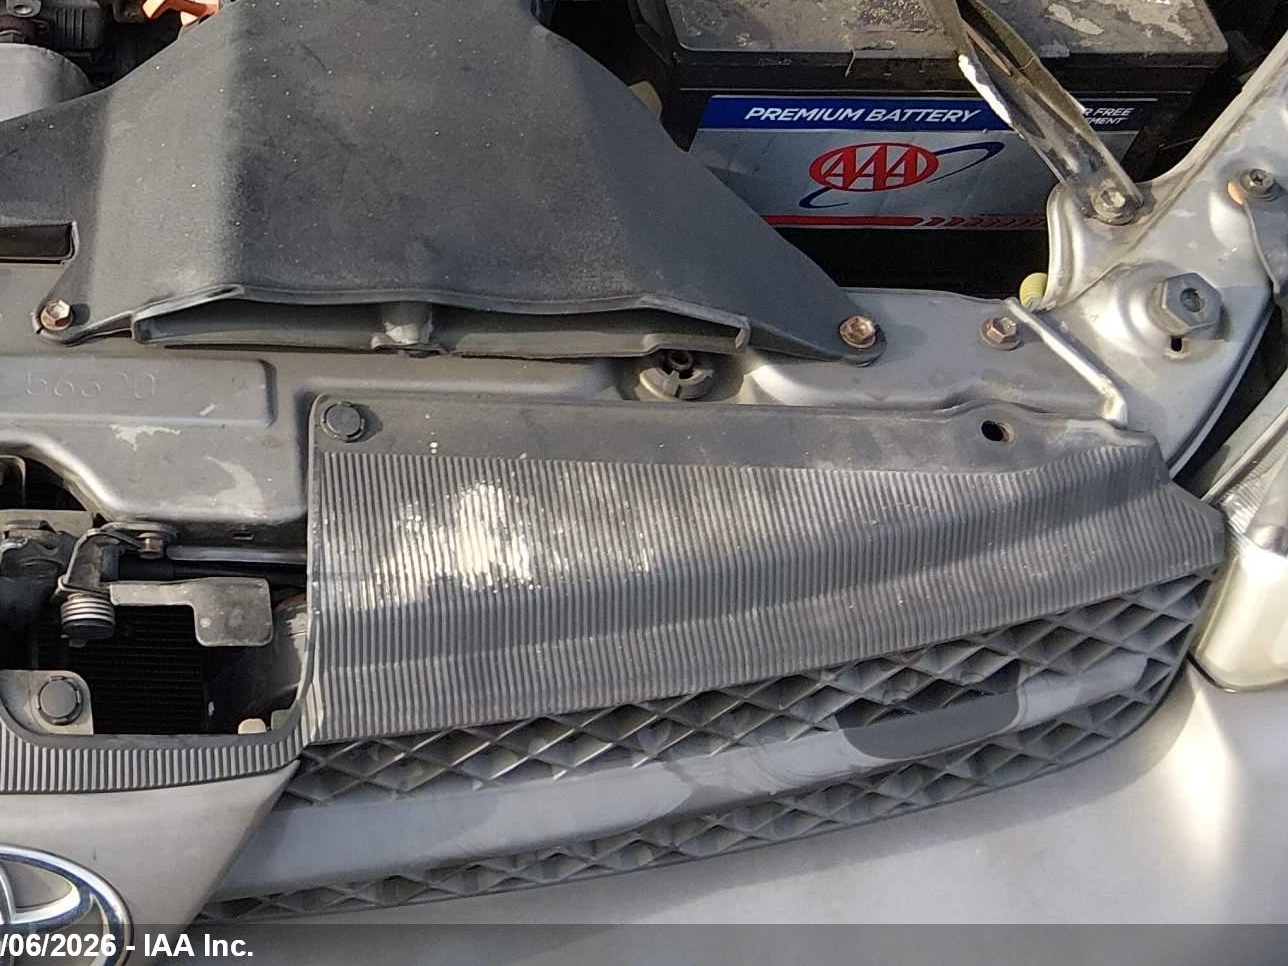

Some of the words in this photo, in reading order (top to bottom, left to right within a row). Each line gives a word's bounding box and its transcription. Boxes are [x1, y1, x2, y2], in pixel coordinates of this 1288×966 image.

[744, 107, 863, 122] PREMIUM
[865, 107, 982, 123] BATTERY
[1093, 107, 1136, 116] FREE
[818, 144, 934, 191] AAA
